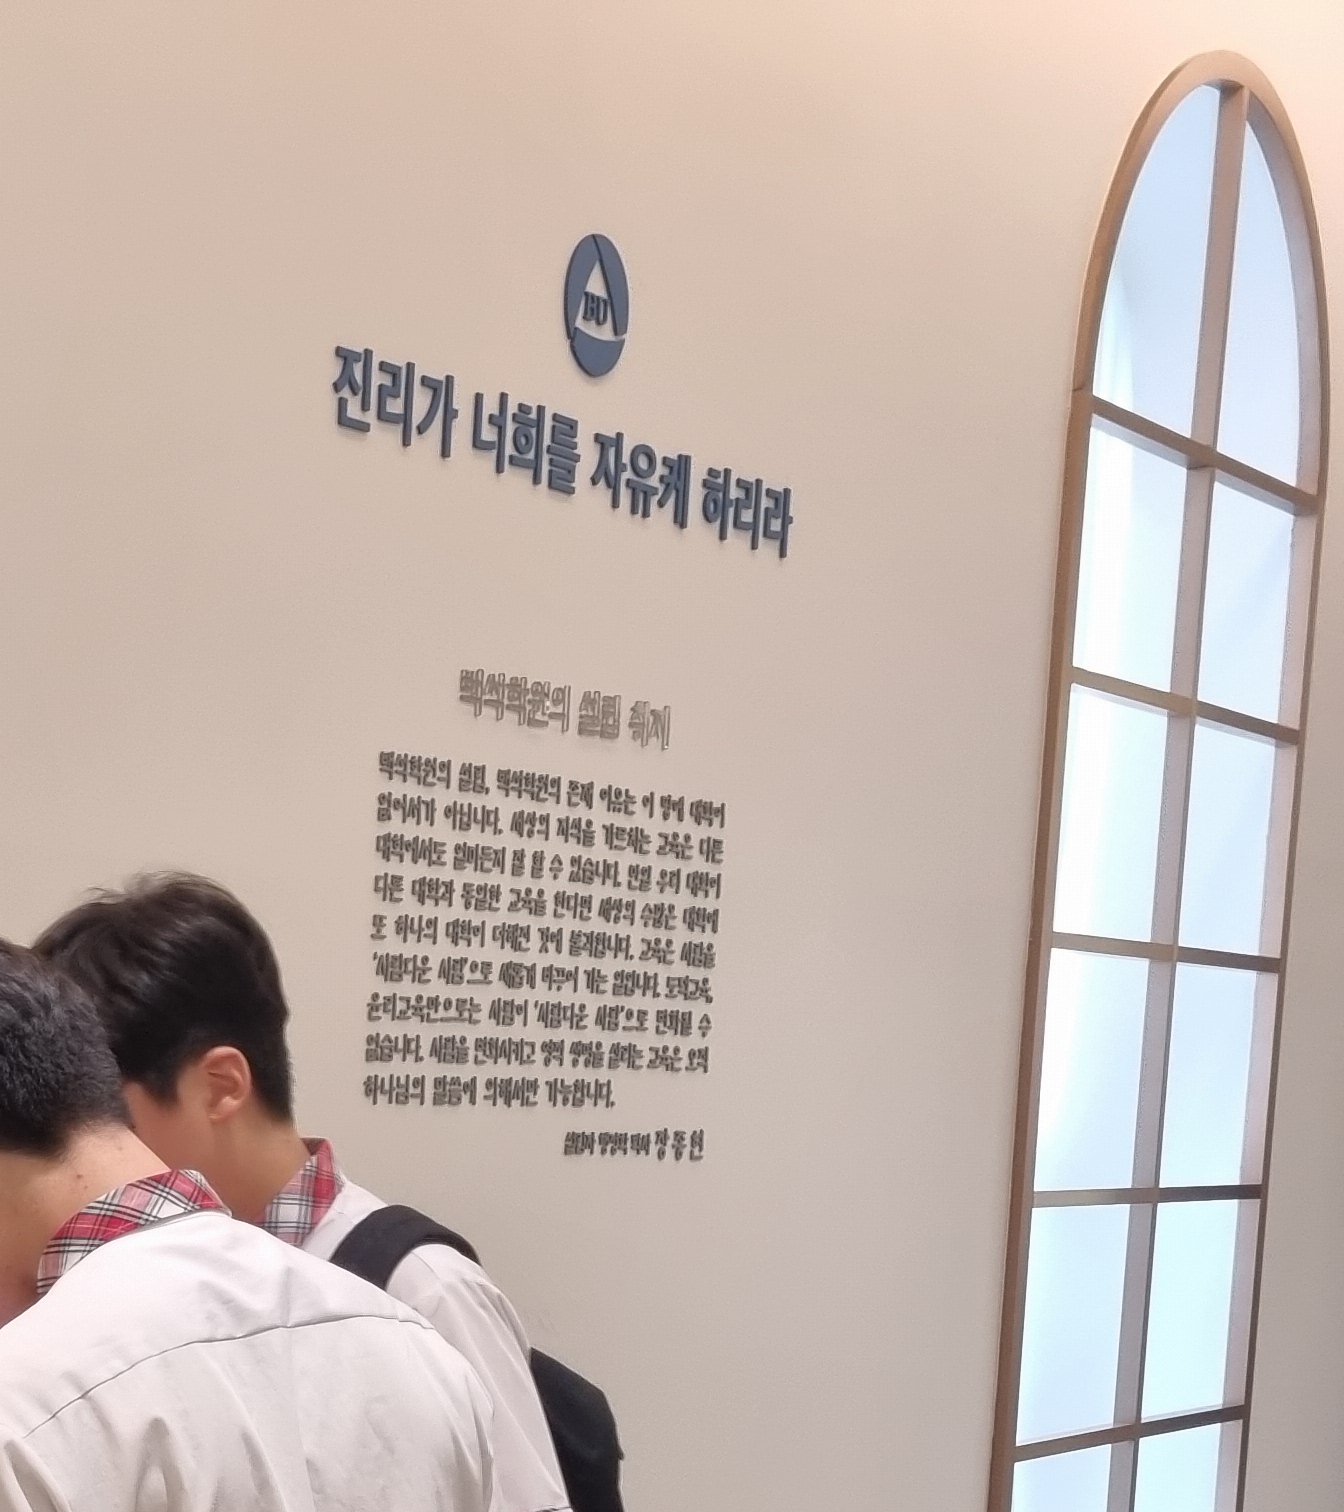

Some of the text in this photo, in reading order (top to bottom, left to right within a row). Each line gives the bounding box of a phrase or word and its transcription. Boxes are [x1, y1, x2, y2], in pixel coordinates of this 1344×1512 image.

[332, 345, 794, 560] 진리가 너희를 자유케 하리라
[459, 669, 671, 750] 백석학원의 설립 취지
[378, 751, 452, 790] 백석학원의
[496, 768, 562, 805] 백석학원의
[566, 779, 595, 810] 존재
[599, 784, 637, 817] 이유는
[641, 791, 655, 819] 이
[659, 794, 685, 823] 땅에
[689, 799, 726, 829] 대학이
[376, 791, 437, 827] 없어서가
[509, 809, 551, 842] 세상의
[556, 815, 596, 848] 지식을
[656, 831, 694, 860] 교육은
[698, 836, 724, 865] 다른
[375, 832, 447, 868] 대학에서도
[453, 841, 507, 875] 얼마든지
[511, 848, 527, 877] 잘
[530, 850, 546, 880] 할
[548, 853, 564, 881] 수
[627, 863, 652, 892] 만일
[656, 868, 682, 895] 우리
[685, 870, 722, 900] 대학이
[373, 872, 720, 934] 다른 대학과 동일한 교육을 한다면 세상의 수많은 대학에
[370, 914, 388, 941] 또
[394, 913, 439, 946] 하나의
[445, 917, 486, 948] 대학이
[537, 926, 564, 955] 것에
[638, 937, 675, 966] 교육은
[679, 940, 716, 970] 사람을
[541, 963, 580, 994] 바꾸어
[583, 967, 609, 995] 가는
[366, 991, 482, 1025] 윤리교육만으로는
[488, 997, 529, 1028] 사람이
[697, 1013, 712, 1038] 수
[428, 1034, 470, 1064] 사람을
[473, 1036, 536, 1066] 변화시키고
[540, 1038, 565, 1068] 영적
[568, 1040, 605, 1069] 생명을
[646, 1044, 683, 1073] 교육은
[684, 1046, 710, 1074] 오직
[362, 1073, 426, 1106] 하나님의
[432, 1074, 478, 1107] 말씀에
[482, 1076, 540, 1109] 의해서만
